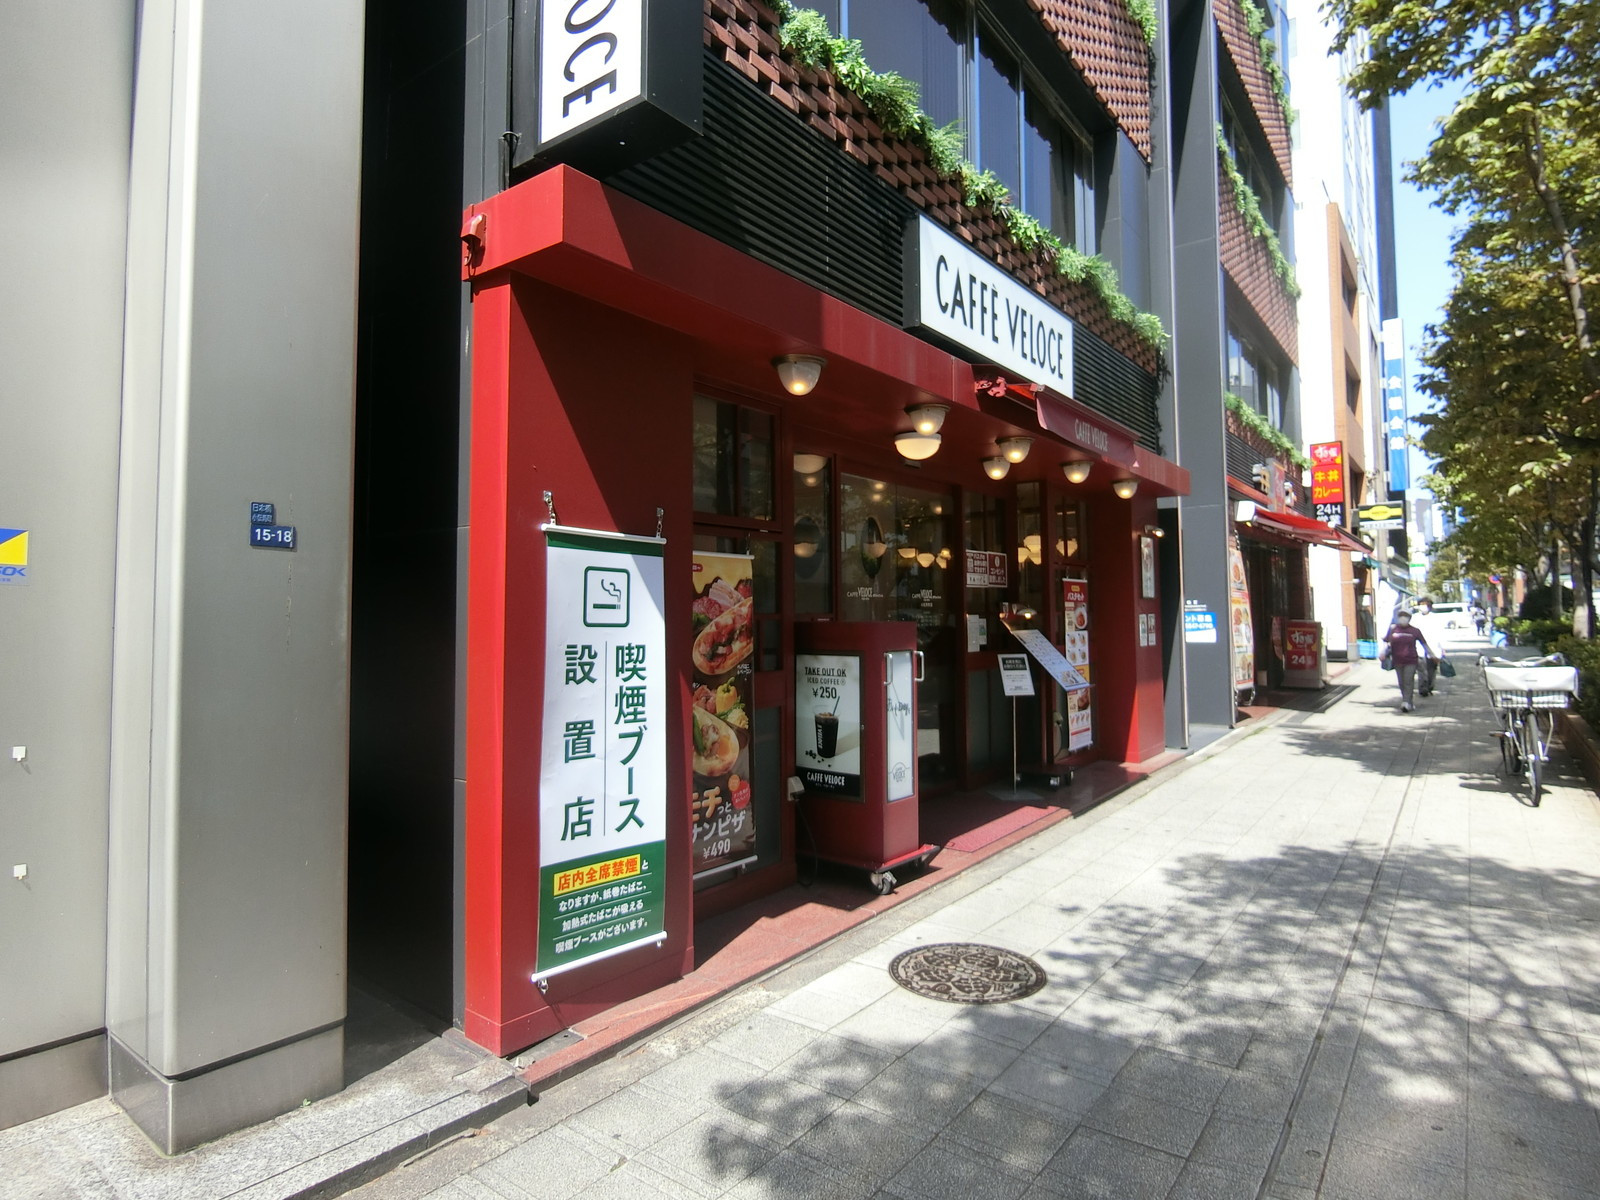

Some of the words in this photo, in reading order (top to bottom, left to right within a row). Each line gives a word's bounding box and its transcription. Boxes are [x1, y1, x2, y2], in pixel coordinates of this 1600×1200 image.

[1005, 297, 1063, 380] VELOCE
[1314, 470, 1339, 483] 牛丼
[1314, 486, 1341, 499] カレー
[1316, 504, 1341, 516] 24H
[255, 528, 292, 543] 15-18
[804, 666, 821, 676] TAKE
[822, 668, 836, 677] OUT
[837, 669, 847, 678] OK
[820, 678, 840, 686] COFFEE
[812, 687, 837, 699] ¥250
[560, 644, 598, 841] 設置店
[614, 643, 648, 833] 喫煙ブース
[824, 774, 846, 787] VELOCE
[703, 838, 731, 859] ¥490
